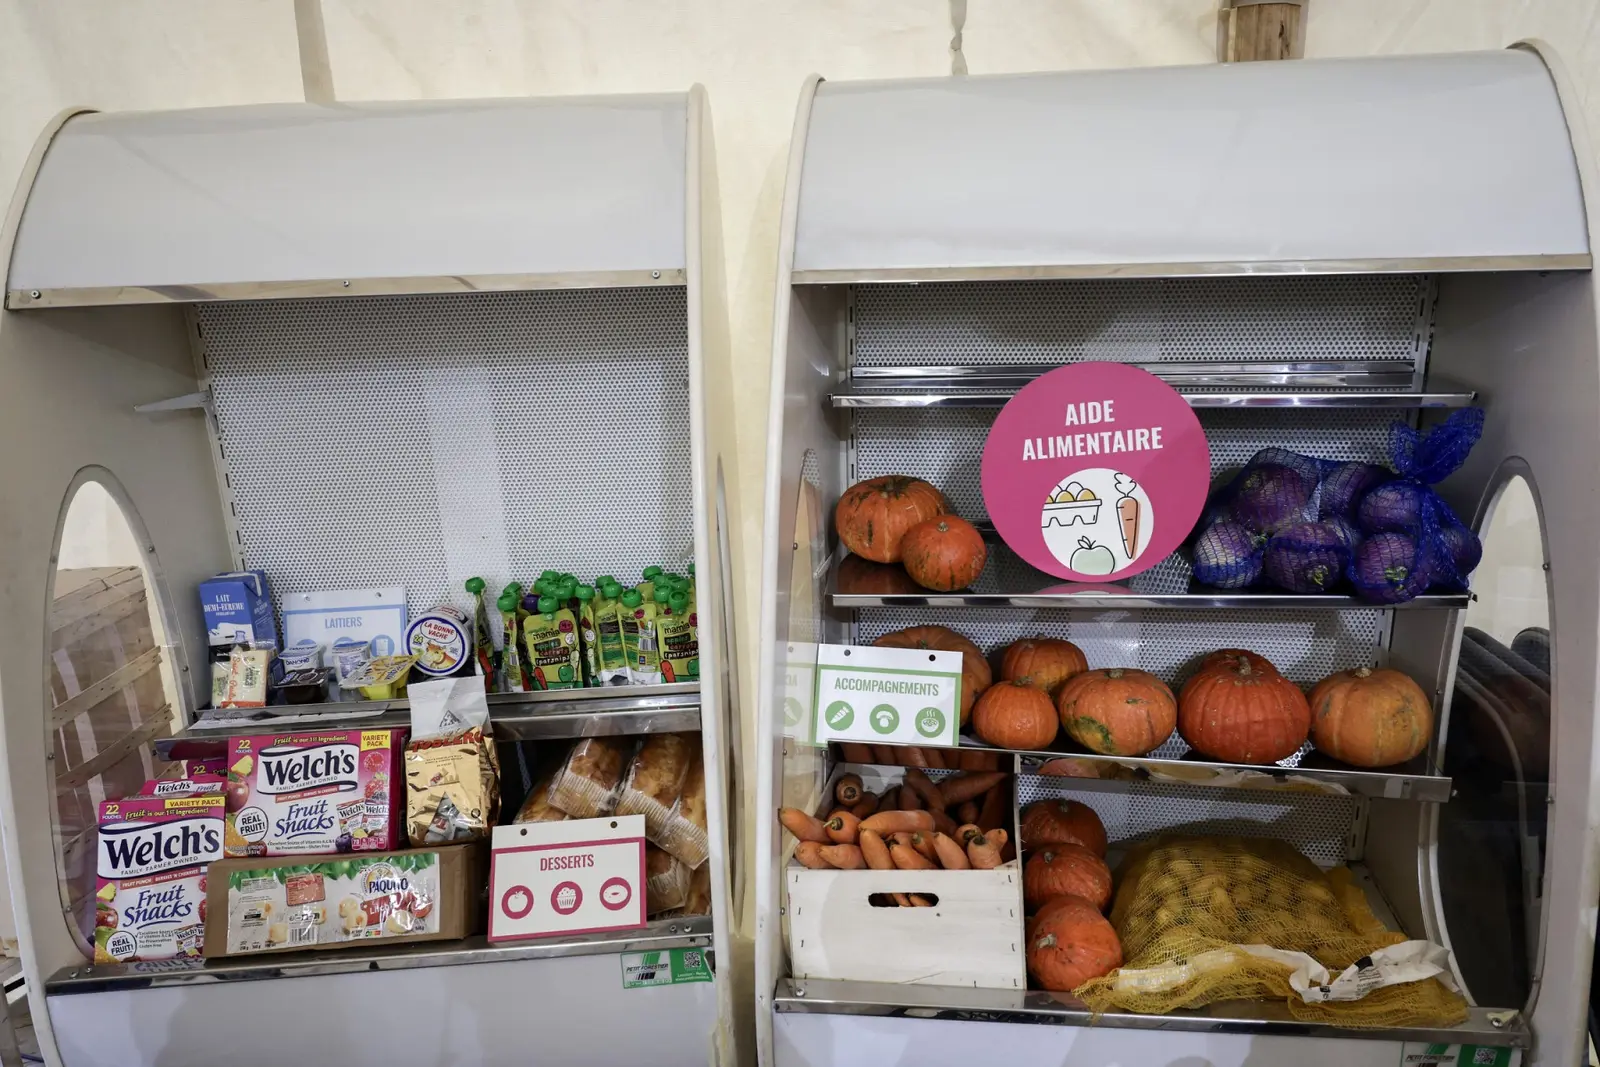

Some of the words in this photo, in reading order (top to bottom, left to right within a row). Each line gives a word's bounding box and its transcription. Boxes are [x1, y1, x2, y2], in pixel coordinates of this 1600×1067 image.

[1065, 400, 1115, 426] AIDE
[1022, 427, 1163, 461] ALIMENTAIRE
[215, 594, 230, 603] LAIT
[325, 616, 362, 629] LAITIERS
[424, 621, 432, 629] LA
[433, 624, 455, 636] BONNE
[428, 629, 449, 640] VACHE
[834, 677, 939, 696] ACCOMPAGNEMENTS
[239, 739, 251, 749] 22
[274, 735, 291, 746] Fruit
[318, 735, 348, 744] Ingredient!
[193, 765, 206, 774] 22
[262, 749, 355, 786] Welch's
[158, 782, 190, 793] Welch's
[196, 784, 216, 793] Fruit
[296, 779, 318, 788] FARMER
[105, 804, 120, 815] 22
[125, 809, 145, 820] Fruit
[175, 807, 209, 816] Ingredient!
[287, 800, 328, 820] Fruit
[241, 814, 262, 825] REAL
[274, 815, 335, 837] Snacks
[240, 821, 266, 835] FRUIT!
[103, 824, 220, 869] Welch's
[121, 868, 142, 876] FAMILY
[145, 861, 171, 872] FARMER
[173, 856, 199, 864] OWNED
[539, 853, 595, 871] DESSERTS
[136, 878, 152, 886] PUNCH
[137, 884, 185, 909] Fruit
[122, 900, 193, 928] Snacks
[112, 937, 130, 947] REAL
[111, 944, 134, 955] FRUIT!
